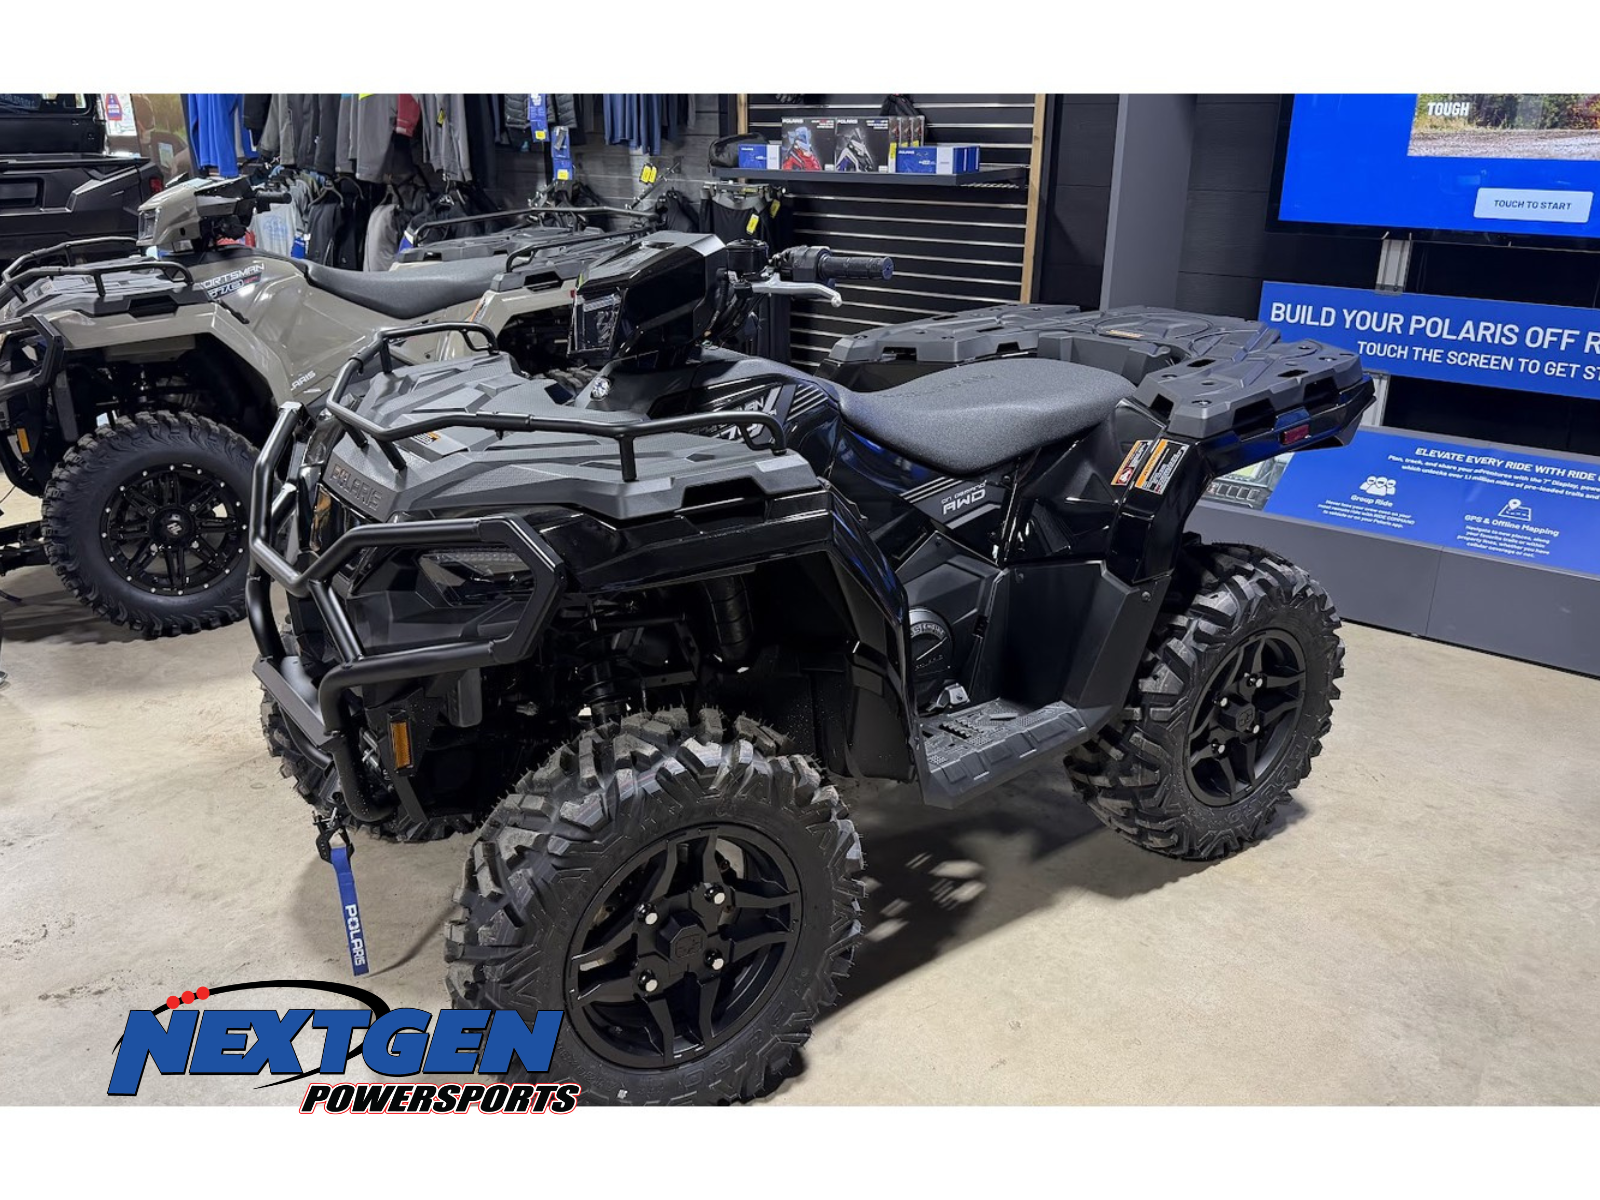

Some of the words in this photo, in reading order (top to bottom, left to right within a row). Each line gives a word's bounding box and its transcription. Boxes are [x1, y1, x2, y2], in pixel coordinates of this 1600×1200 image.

[1427, 101, 1470, 116] TOUGH
[1494, 199, 1525, 208] TOUCH
[1526, 201, 1539, 209] TO
[1540, 201, 1572, 210] START
[200, 263, 265, 290] ORTSMAN
[1270, 302, 1337, 327] BUILD
[1342, 308, 1403, 333] YOUR
[1409, 315, 1519, 346] POLARIS
[1525, 326, 1581, 351] OFF
[1357, 340, 1409, 360] TOUCH
[1412, 346, 1443, 363] THE
[1446, 350, 1515, 371] SCREEN
[1518, 358, 1541, 374] TO
[1543, 362, 1581, 378] GET
[1415, 447, 1465, 463] ELEVATE
[1465, 455, 1504, 468] EVERY
[1505, 461, 1534, 472] RIDE
[1535, 465, 1567, 478] WITH
[1567, 470, 1597, 481] RIDE
[330, 464, 383, 511] POLARIS
[1513, 473, 1529, 482] with
[1529, 475, 1542, 484] the
[1516, 481, 1524, 489] of
[943, 489, 986, 515] AWD
[1350, 494, 1375, 505] Group
[1374, 498, 1393, 508] Ride
[1464, 514, 1483, 524] GPS
[1491, 519, 1521, 530] Offline
[1521, 524, 1560, 538] Mapping
[345, 904, 366, 967] POLARIS
